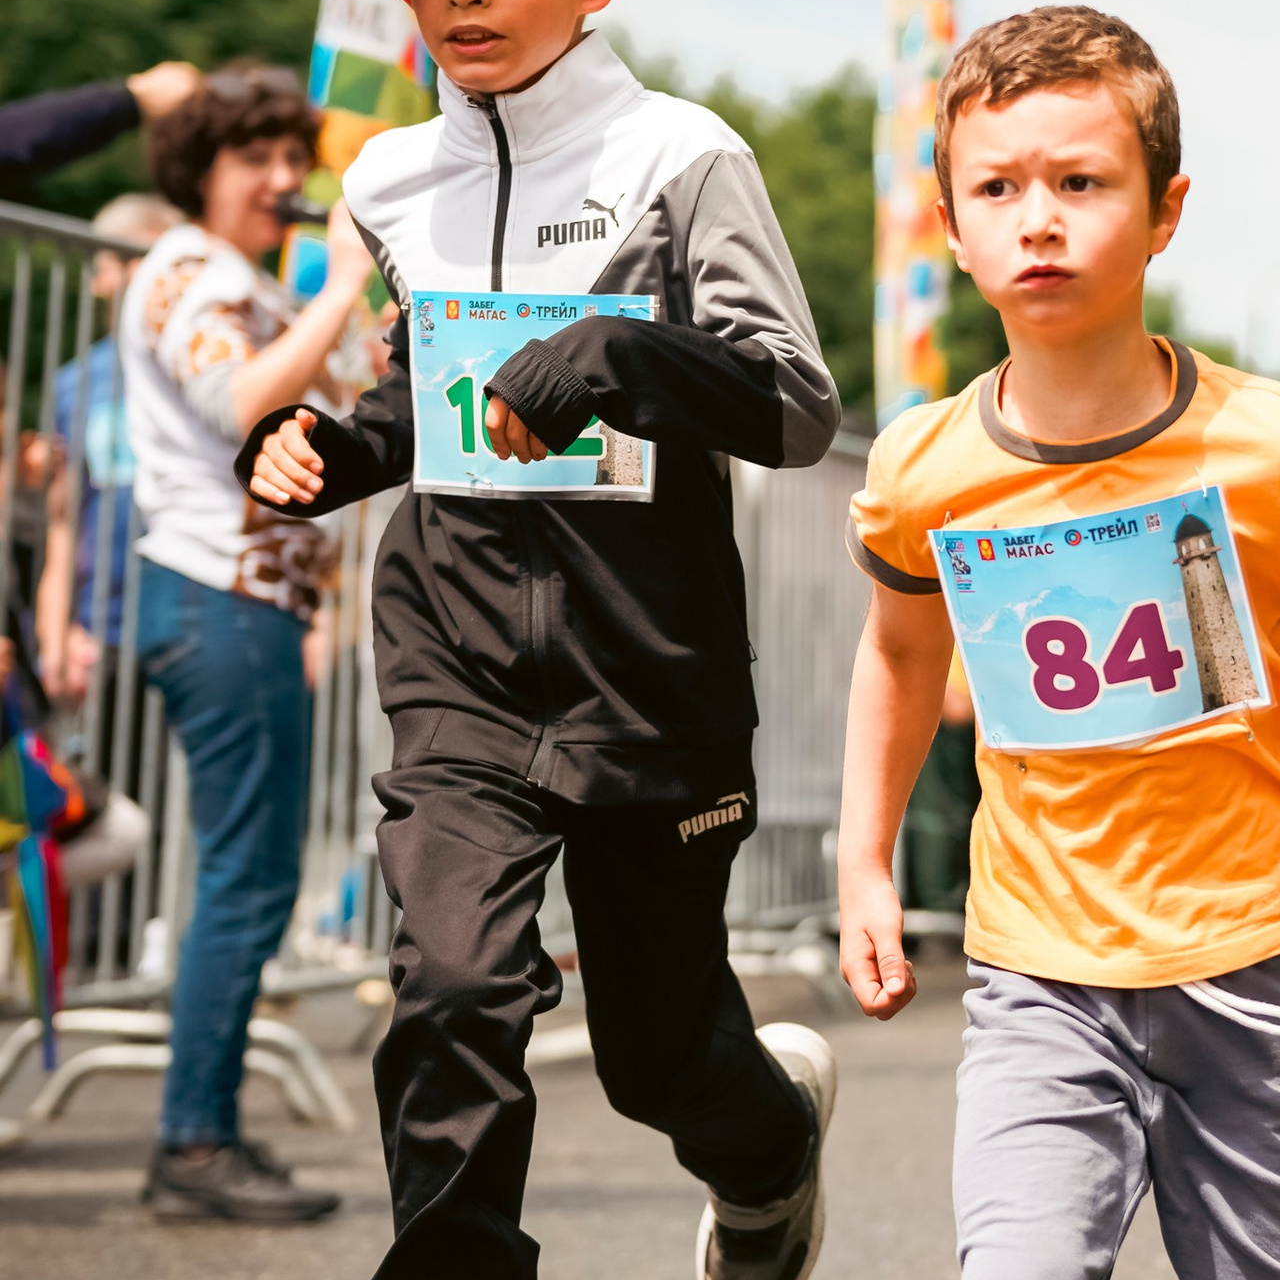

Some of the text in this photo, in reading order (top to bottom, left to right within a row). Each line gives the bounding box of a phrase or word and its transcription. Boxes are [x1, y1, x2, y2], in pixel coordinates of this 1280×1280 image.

[538, 218, 606, 248] PUMA
[468, 300, 496, 309] ЗАБЕГ
[468, 309, 507, 321] МАГАС
[1003, 534, 1036, 547] ЗАБЕГ
[1005, 542, 1055, 560] МАГАС
[1025, 602, 1184, 711] 84
[678, 802, 743, 843] PUMA
